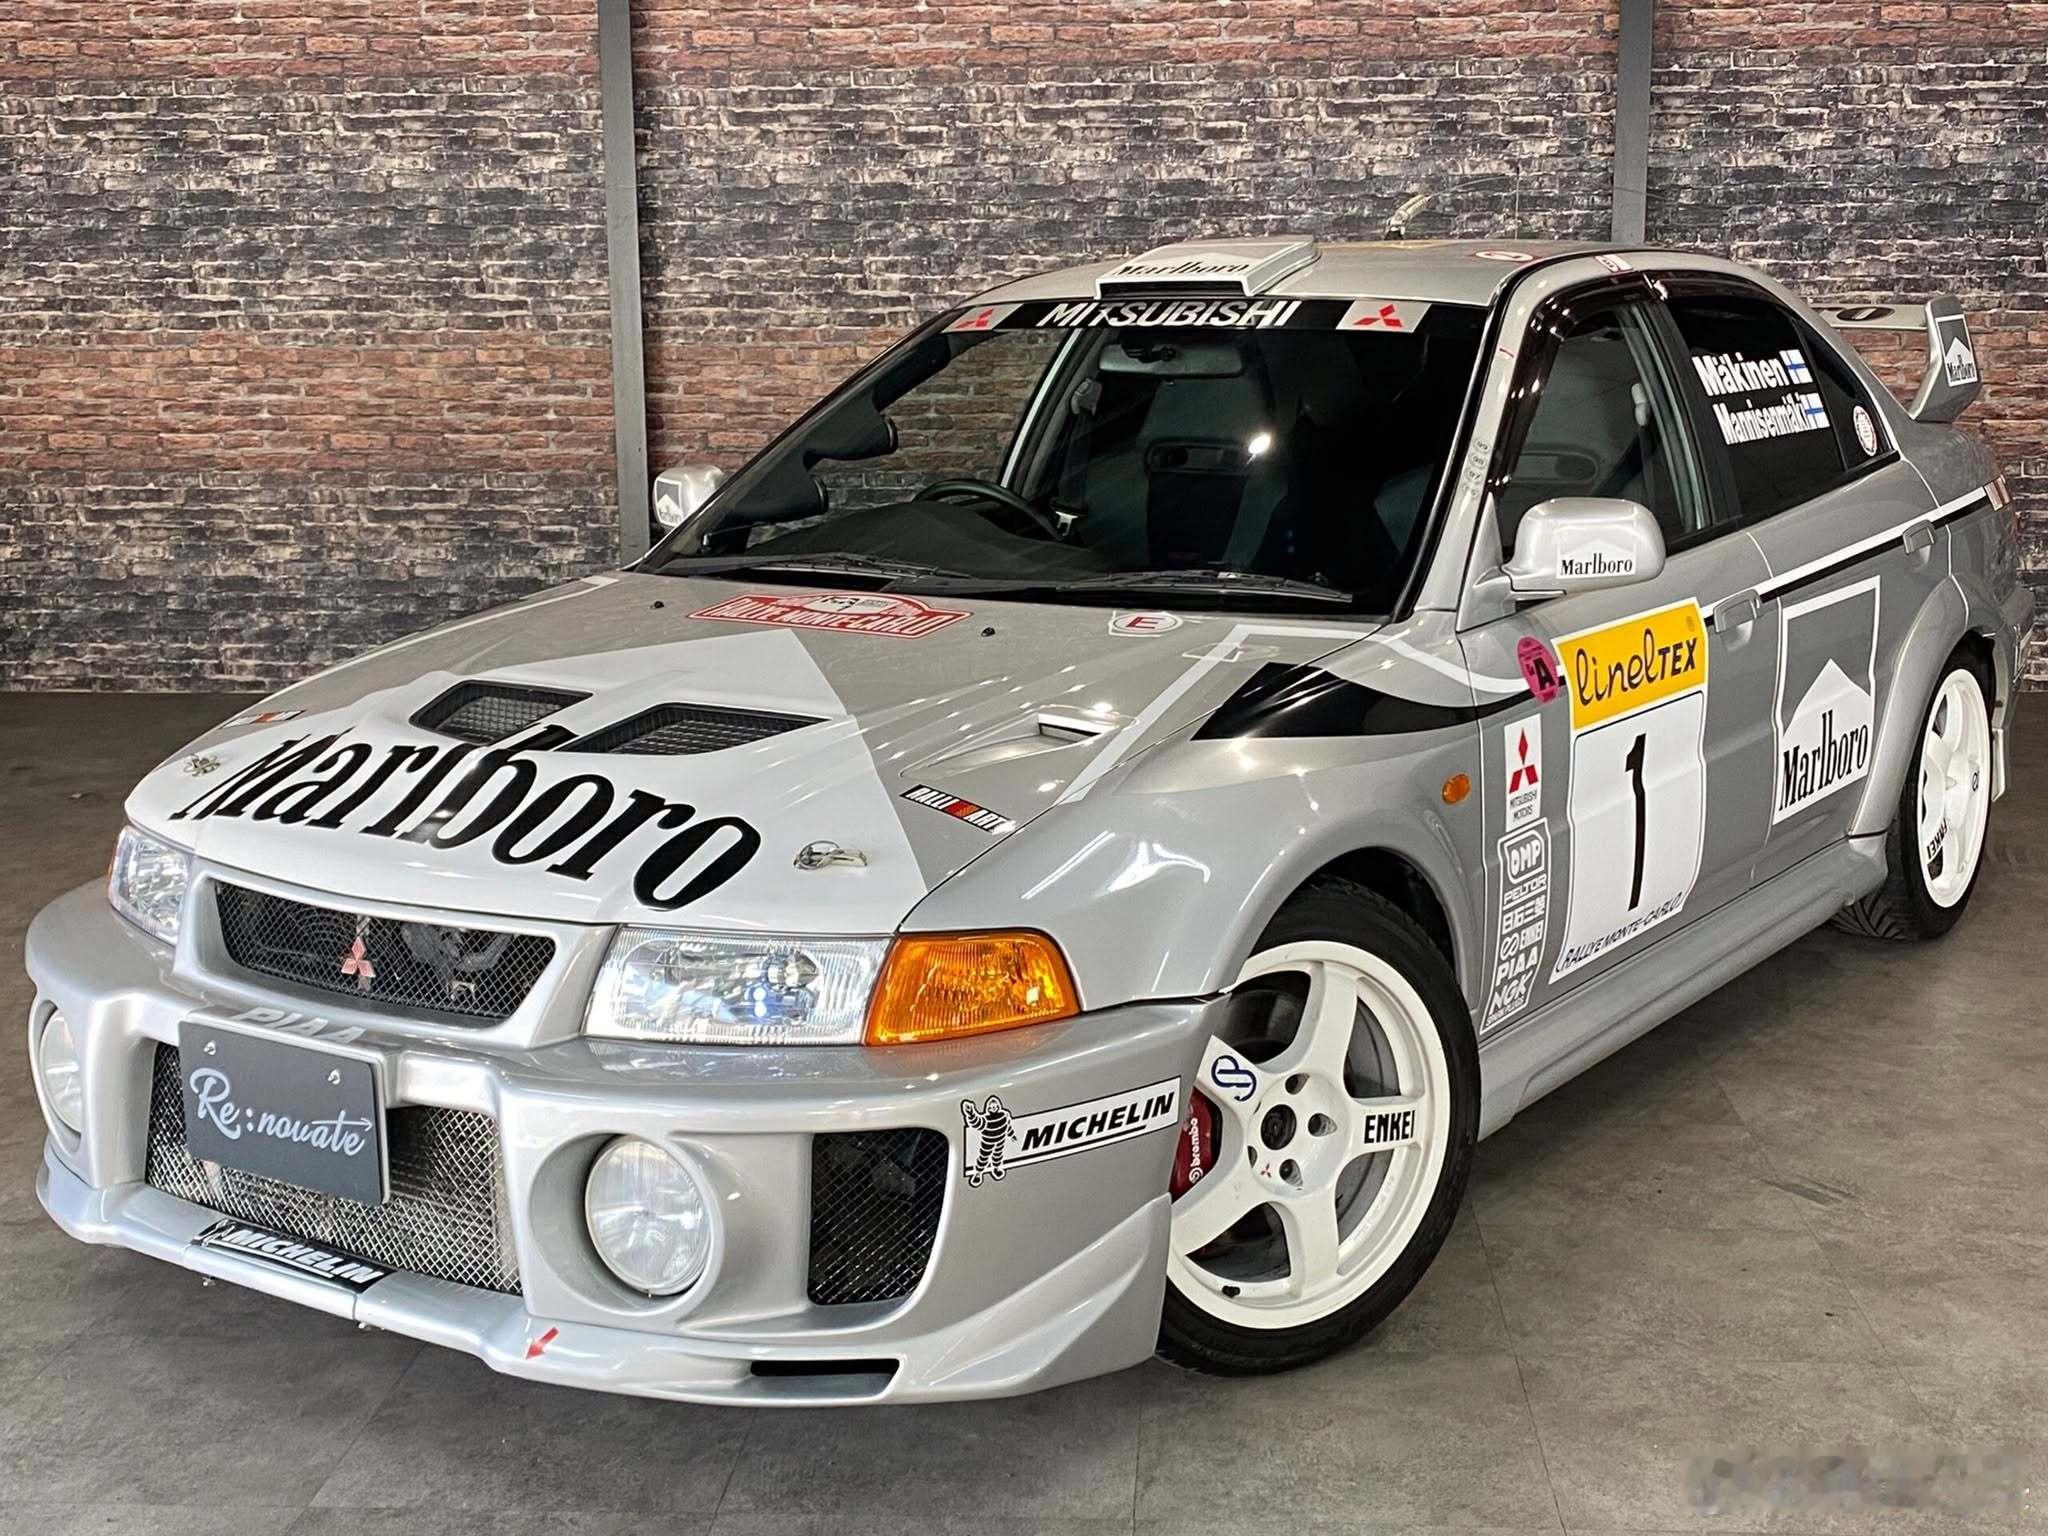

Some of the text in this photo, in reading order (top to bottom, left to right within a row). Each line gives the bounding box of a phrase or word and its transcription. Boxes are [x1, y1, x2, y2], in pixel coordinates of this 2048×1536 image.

[1113, 262, 1249, 276] Marlboro
[1036, 300, 1302, 329] MITSUBISHI
[1691, 351, 1790, 397] Mäkinen
[1560, 553, 1633, 576] Marlboro
[1126, 616, 1166, 629] E
[1533, 656, 1556, 691] A
[1779, 709, 1868, 811] Marlboro
[169, 723, 762, 912] Marlboro
[1625, 733, 1647, 912] 1
[1511, 839, 1541, 876] OMP
[1503, 873, 1547, 905] PELTOR
[1495, 945, 1538, 987] PIAA
[1488, 970, 1533, 1016] NGK
[231, 1006, 369, 1044] PIAA
[1022, 1091, 1175, 1151] MICHELIN
[1363, 1109, 1416, 1145] ENKEI
[1189, 1117, 1199, 1168] brembo
[224, 1228, 385, 1284] MICHELIN
